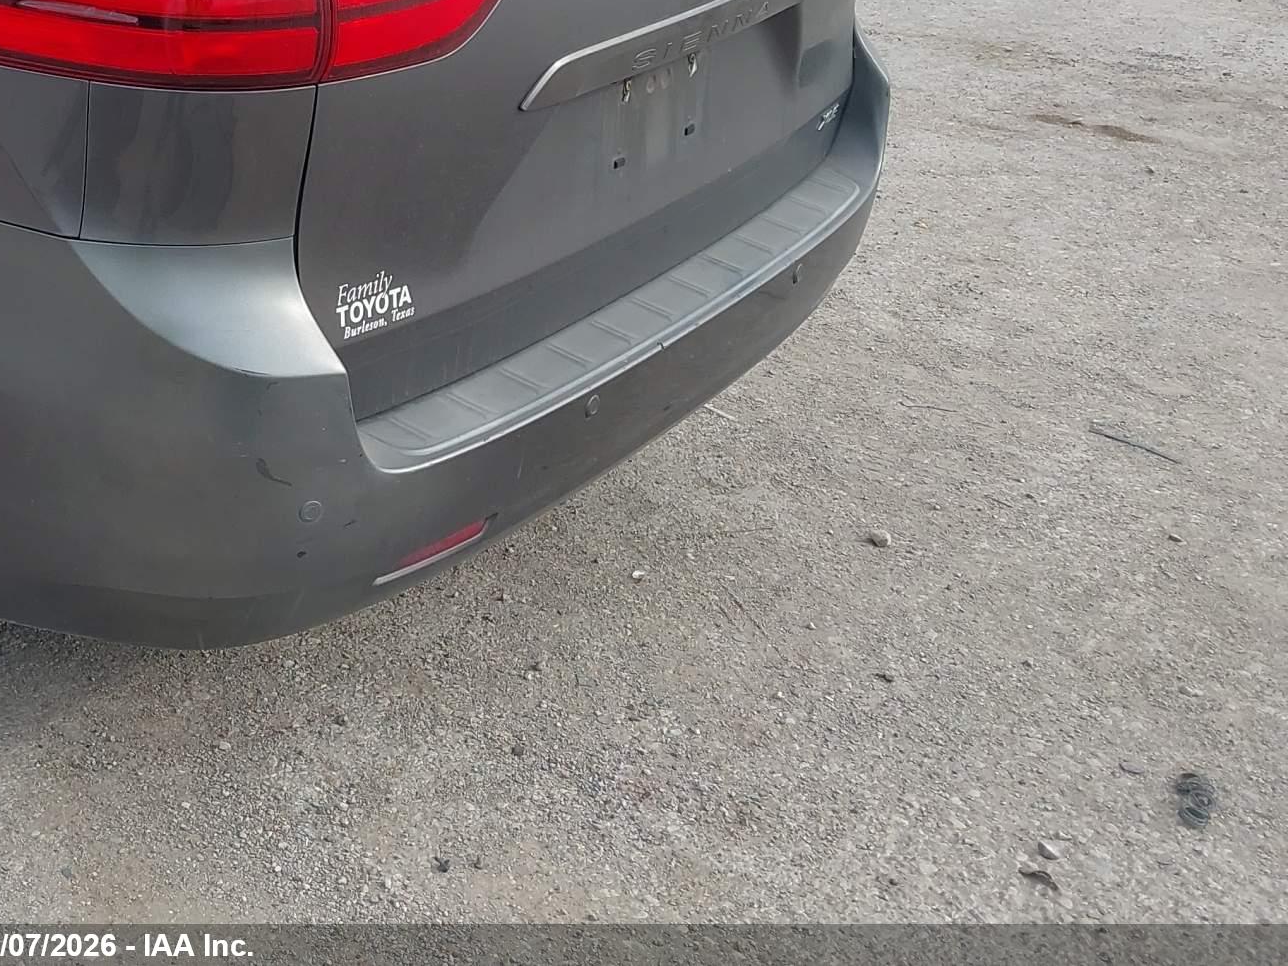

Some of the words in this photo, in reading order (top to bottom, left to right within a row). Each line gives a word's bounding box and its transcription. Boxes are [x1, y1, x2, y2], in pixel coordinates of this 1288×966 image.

[632, 1, 769, 71] SIENNA
[336, 285, 412, 328] TOYOTA
[337, 270, 393, 306] Family
[343, 318, 388, 340] Burleson,
[391, 306, 415, 322] Texas
